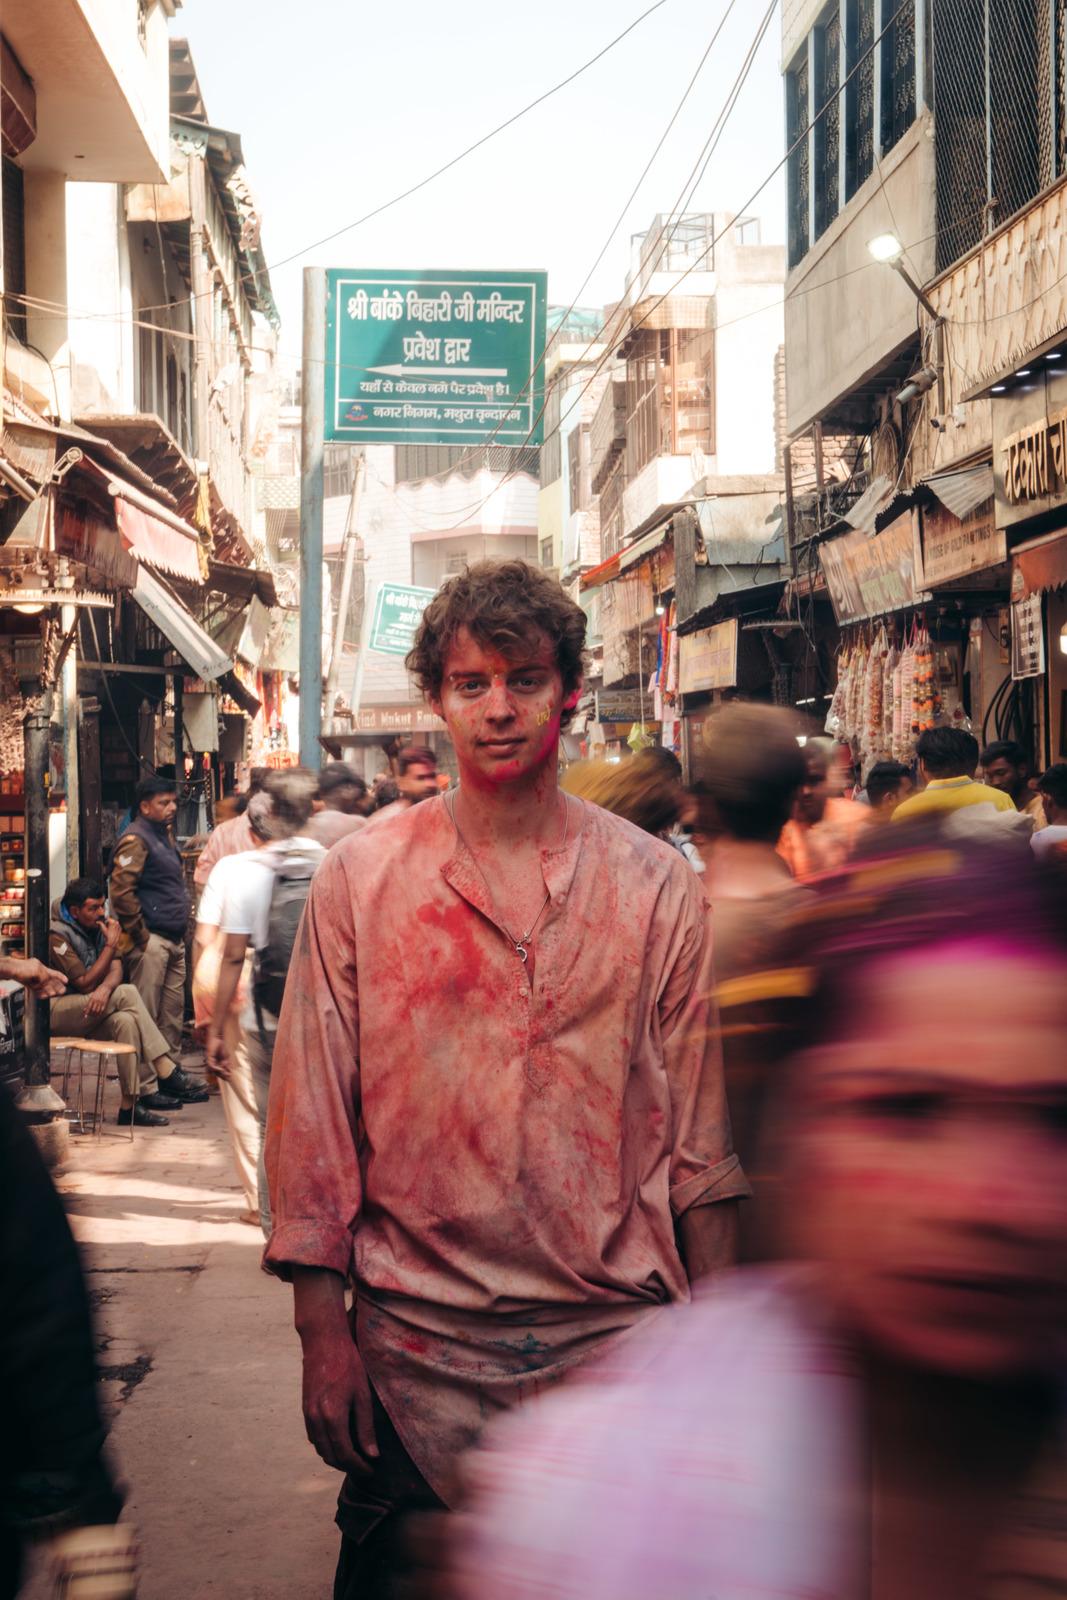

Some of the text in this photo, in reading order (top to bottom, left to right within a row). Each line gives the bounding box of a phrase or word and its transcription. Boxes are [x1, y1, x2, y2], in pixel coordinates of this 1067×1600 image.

[347, 288, 525, 323] श्री बांके बिहारी जी मन्दिर
[403, 330, 472, 364] प्रवेश द्वार
[383, 380, 393, 393] से
[395, 380, 426, 394] केवल
[450, 381, 466, 395] पैर
[373, 404, 521, 424] नगर निगम, मथुरा वृन्दावन
